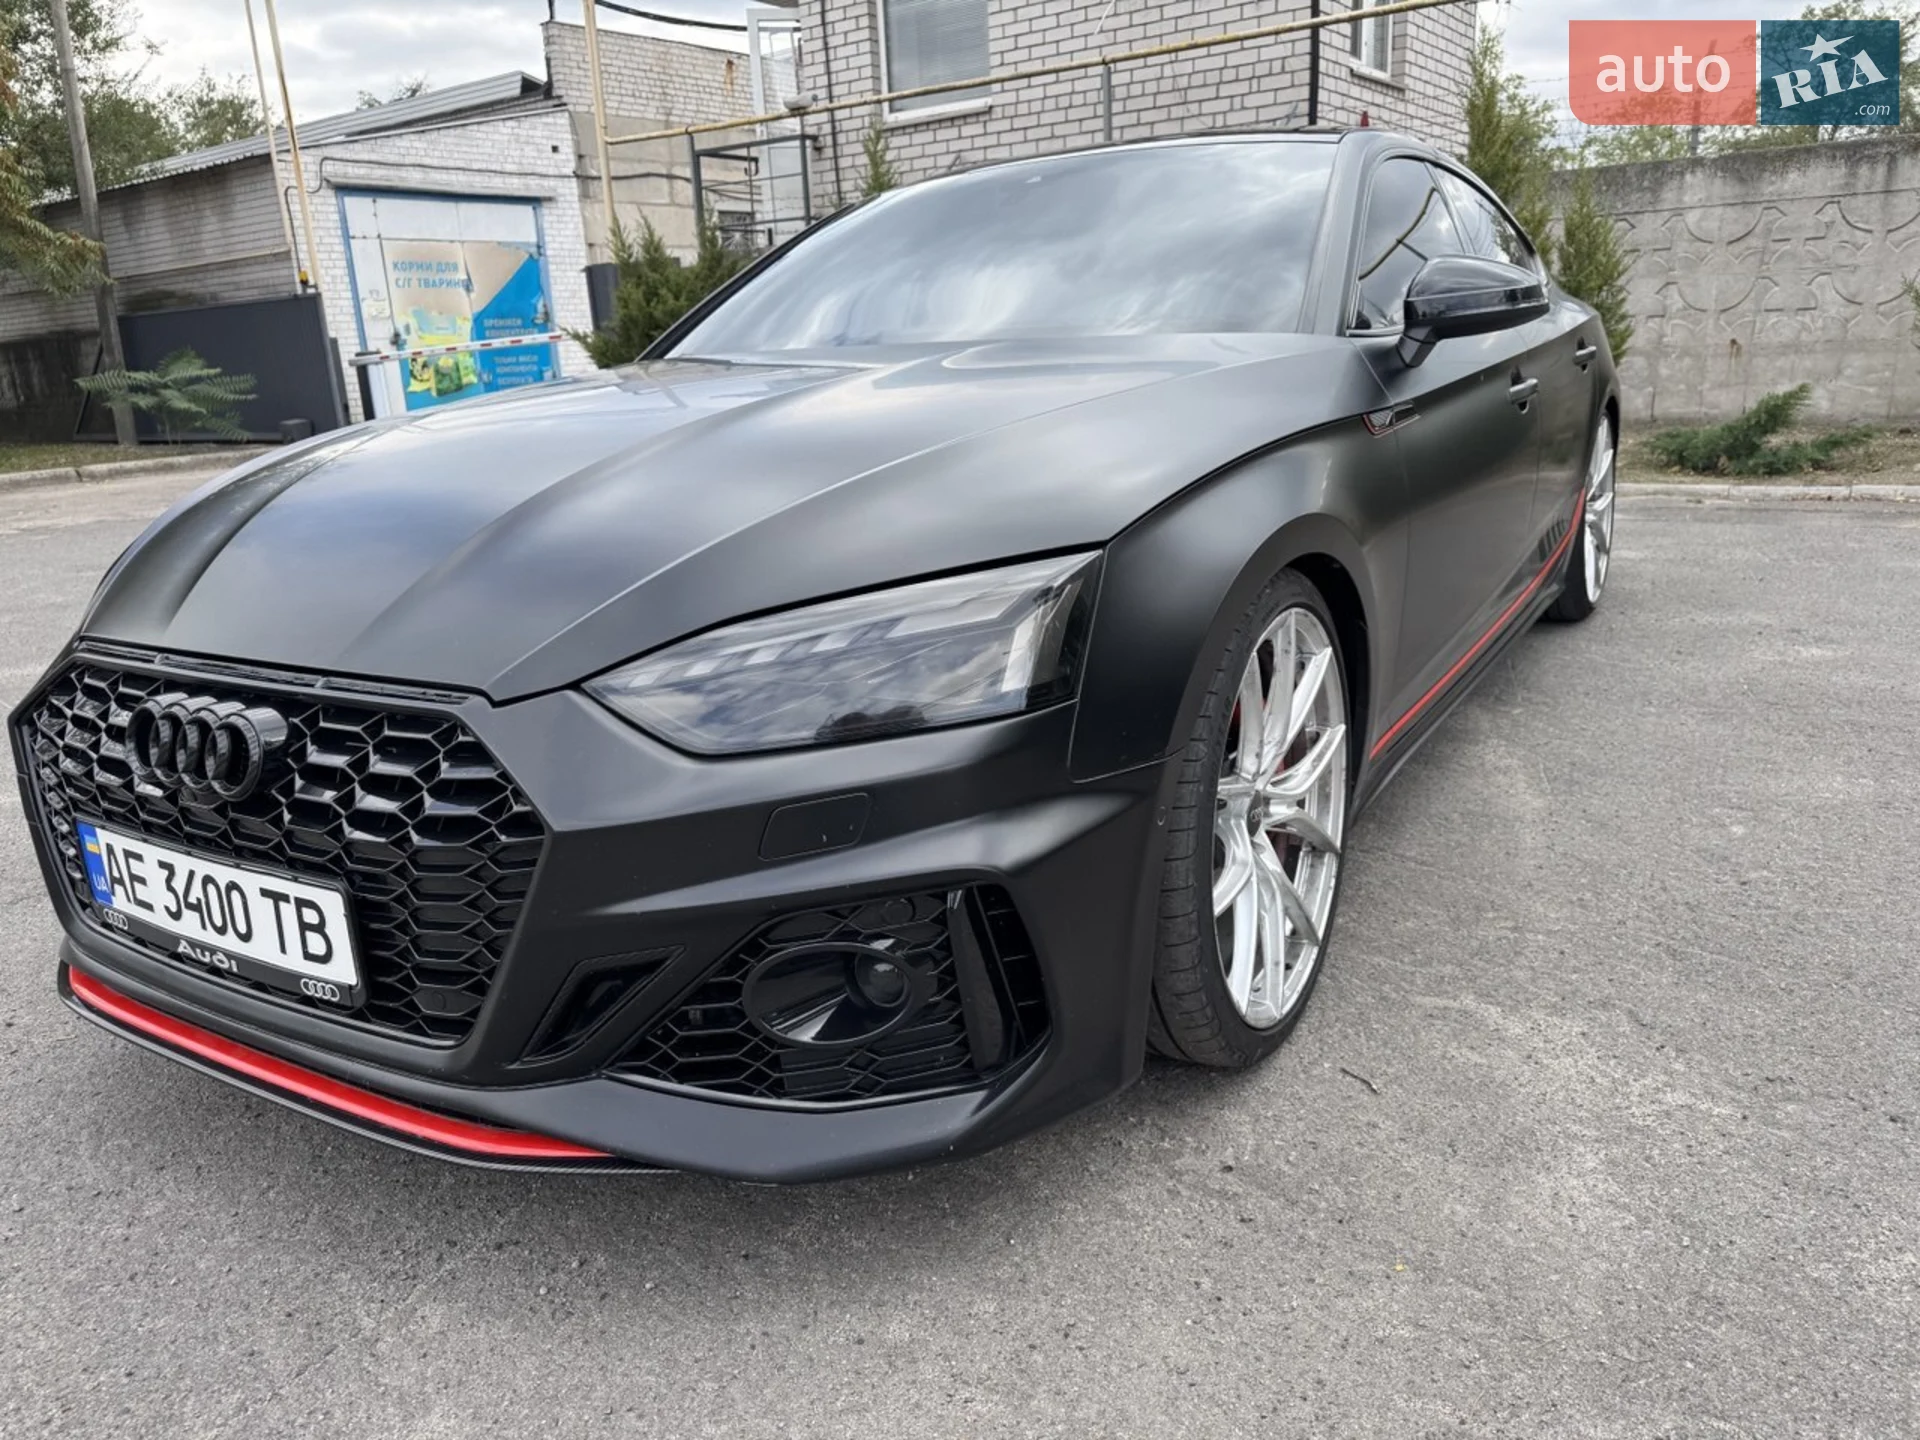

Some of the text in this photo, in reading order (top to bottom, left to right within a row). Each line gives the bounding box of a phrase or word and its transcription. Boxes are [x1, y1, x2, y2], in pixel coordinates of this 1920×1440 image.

[393, 261, 458, 274] КОРМИ ДЛЯ
[93, 873, 109, 892] UA
[106, 843, 333, 965] AE 3400 TB
[177, 939, 240, 973] Audi
